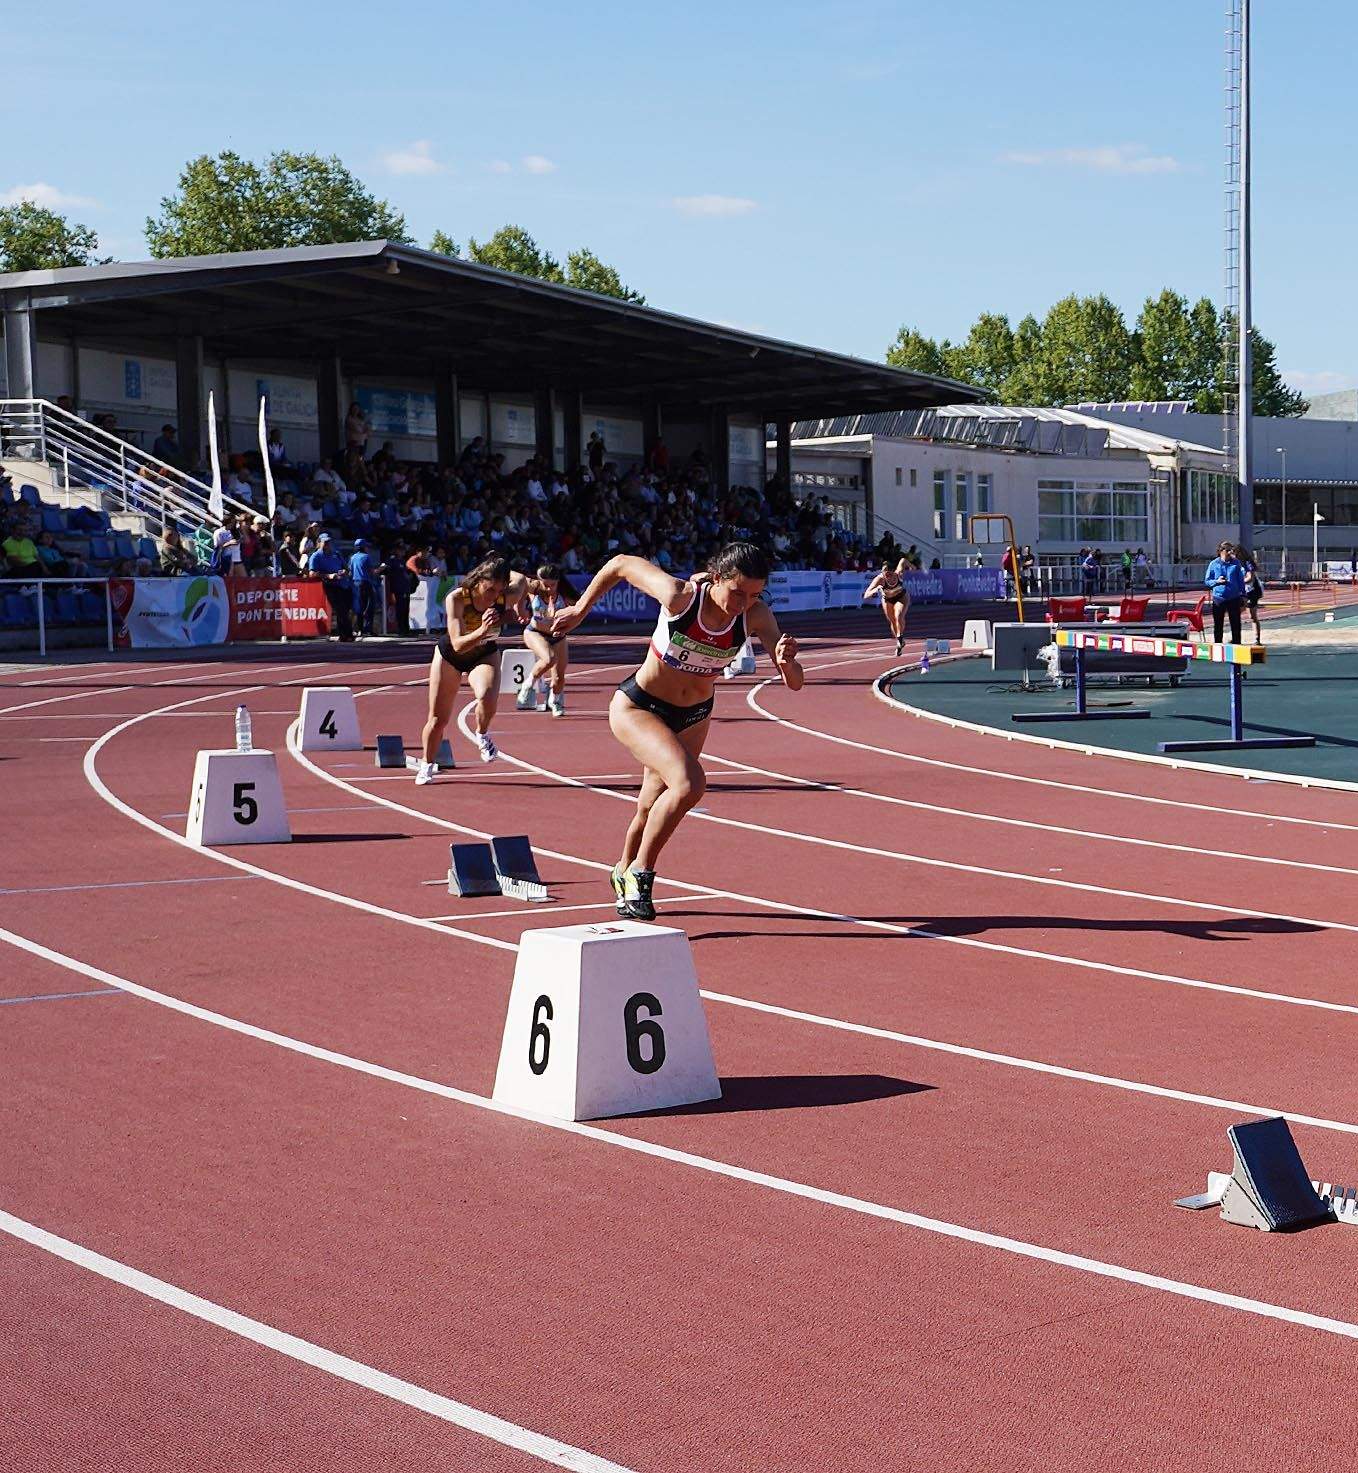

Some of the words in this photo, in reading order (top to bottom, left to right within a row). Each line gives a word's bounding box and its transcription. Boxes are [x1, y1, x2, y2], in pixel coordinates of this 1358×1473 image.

[957, 571, 997, 593] Pontevedra
[236, 588, 299, 604] DEPORTE
[678, 650, 690, 662] 6
[512, 663, 525, 685] 3
[318, 709, 338, 739] 4
[232, 782, 259, 825] 5
[528, 994, 554, 1076] 6
[623, 991, 666, 1075] 6
